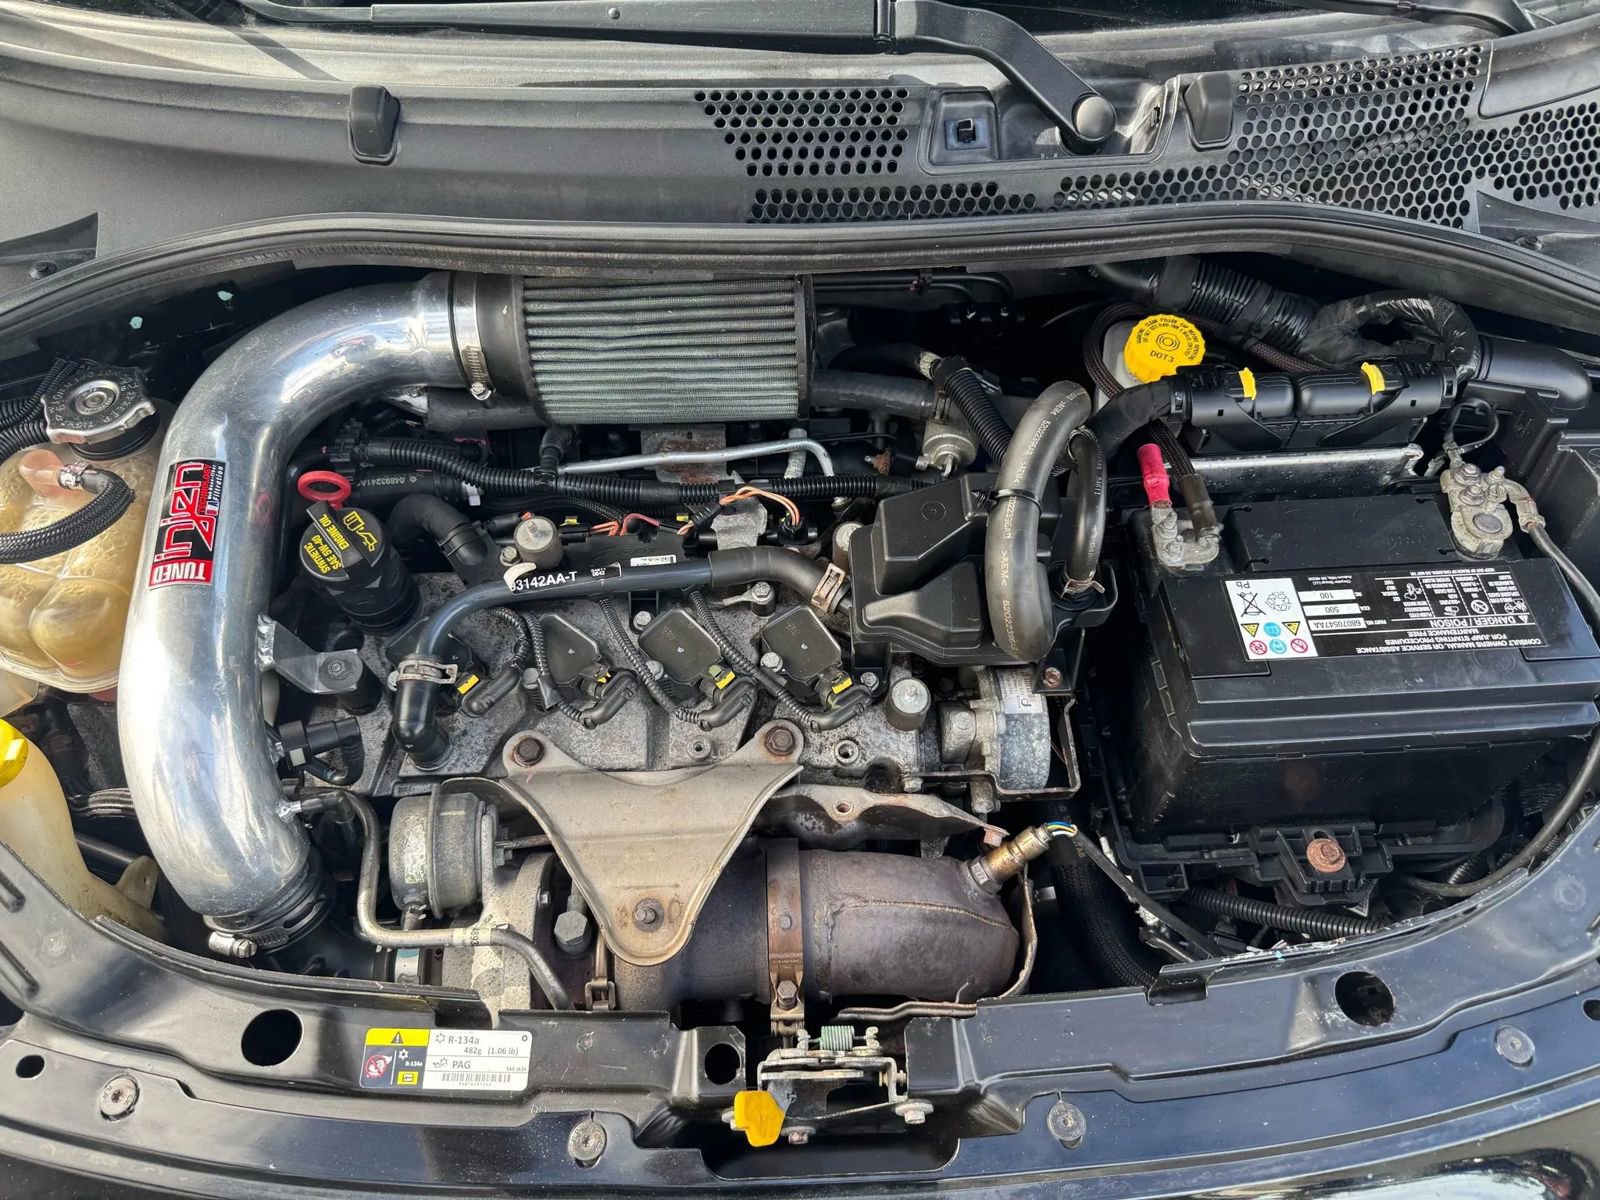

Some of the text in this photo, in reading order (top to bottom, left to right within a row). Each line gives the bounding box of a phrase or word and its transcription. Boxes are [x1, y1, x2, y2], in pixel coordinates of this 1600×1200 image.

[198, 464, 212, 513] TECHNOLOGY
[213, 466, 224, 501] Filtration
[154, 462, 216, 563] injen
[318, 514, 349, 550] ENGINE OIL
[311, 534, 342, 570] SAE 5W-40
[304, 543, 331, 573] SYNTHETIC
[154, 561, 205, 583] TUNED
[1235, 580, 1250, 589] Pb
[1324, 606, 1340, 614] 500
[1313, 620, 1361, 629] 68070547AA
[1429, 618, 1467, 628] POISON
[1474, 615, 1516, 625] DANGER
[1407, 628, 1479, 638] MAINTENANCE FREE
[1385, 637, 1433, 645] PROCEDURES
[1435, 635, 1470, 643] STARTING
[1475, 639, 1508, 647] OWNERS
[1508, 638, 1541, 646] CONSULT
[1355, 646, 1400, 654] ASSISTANCE
[1401, 644, 1432, 652] SERVICE
[1444, 641, 1475, 649] MANUAL
[448, 1035, 480, 1045] R-134a
[463, 1047, 482, 1056] 482g
[487, 1047, 507, 1055] (1.06
[452, 1060, 471, 1070] PAG
